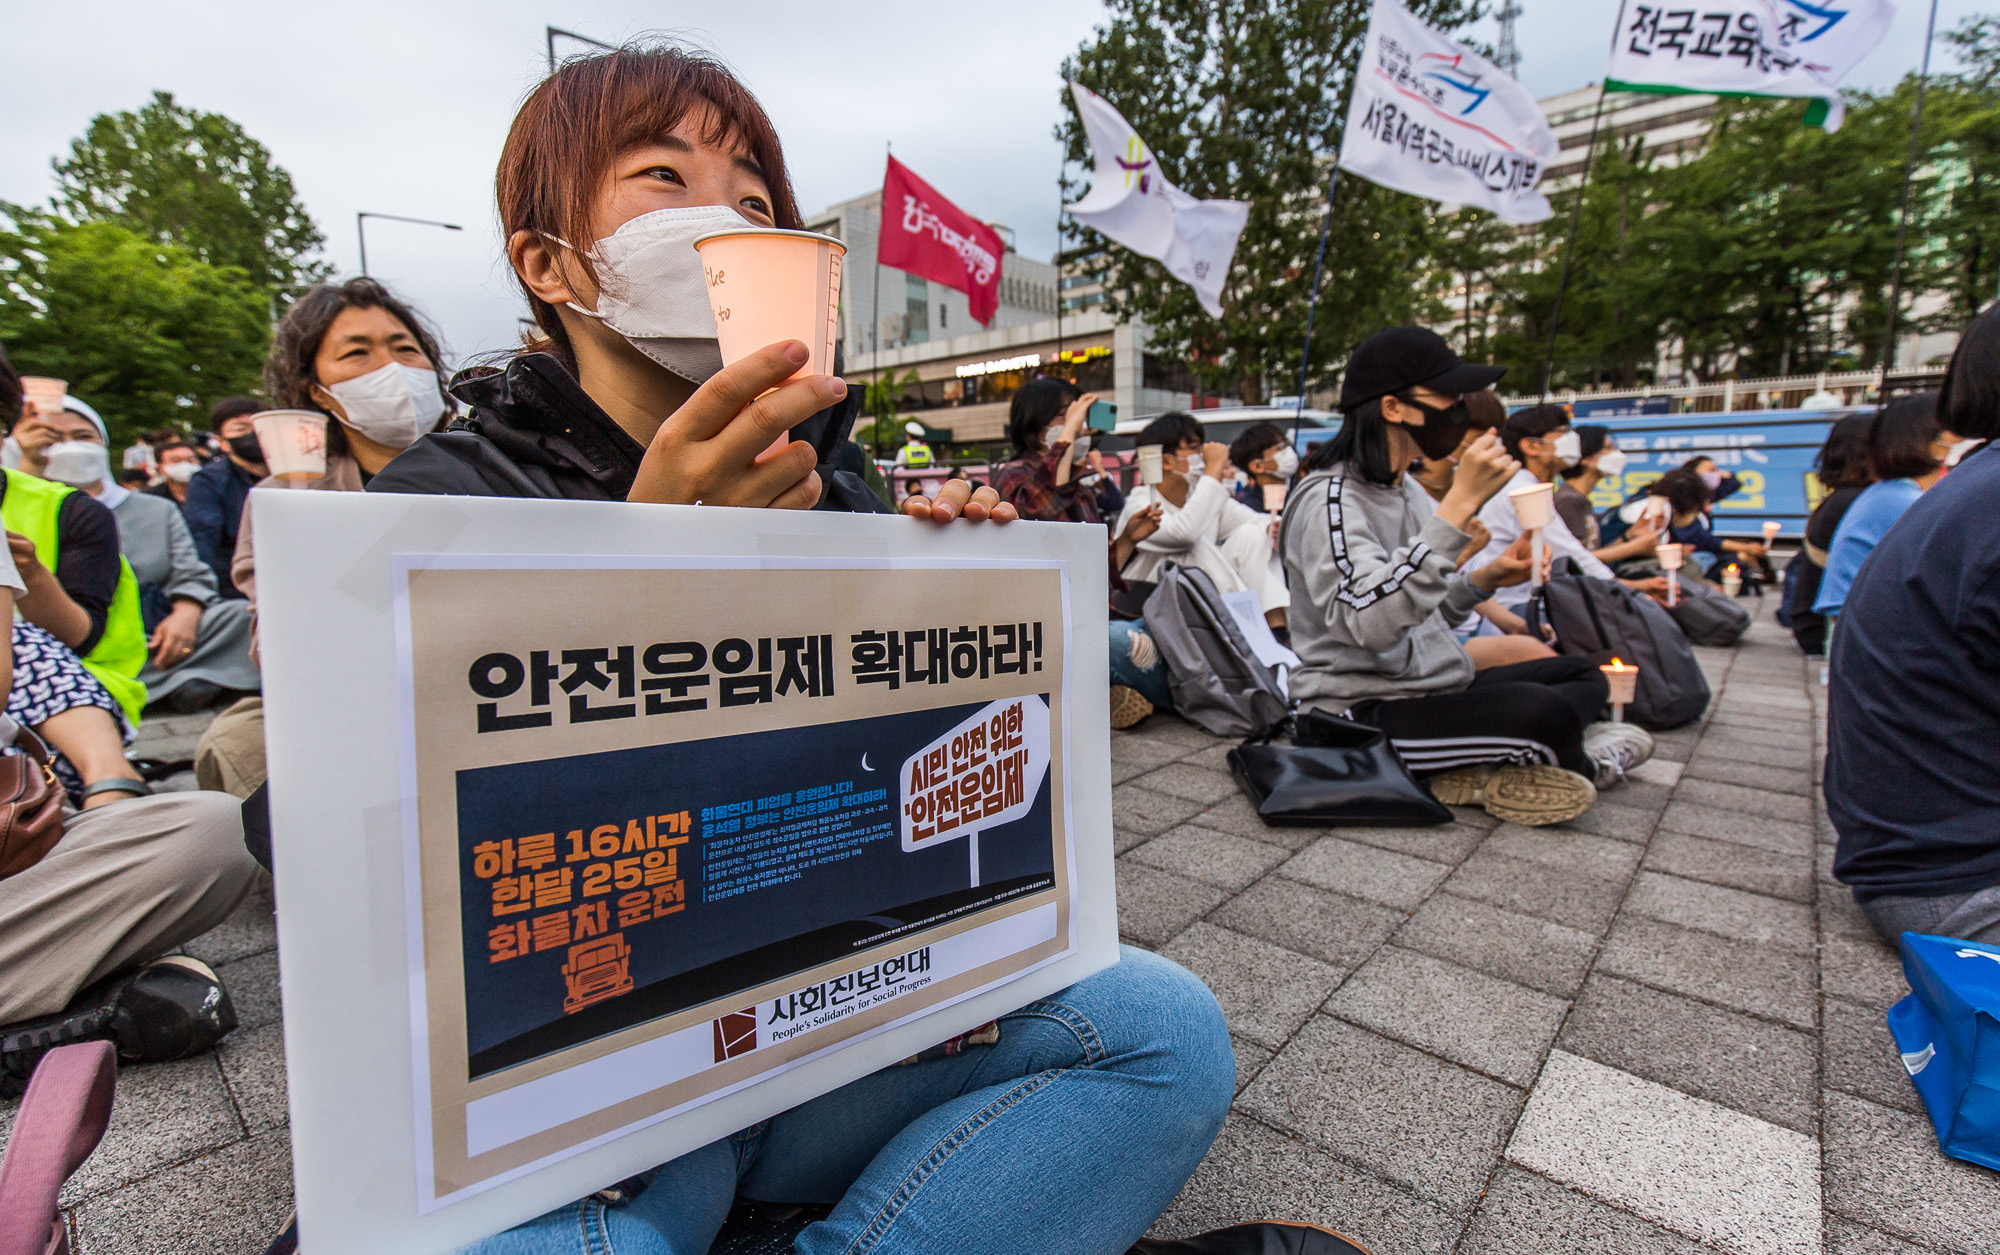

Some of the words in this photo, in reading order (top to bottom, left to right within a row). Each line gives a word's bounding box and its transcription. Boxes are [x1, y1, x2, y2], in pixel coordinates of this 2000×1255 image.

[468, 633, 835, 734] 안전운임제
[850, 621, 1043, 690] 확대하라!
[910, 743, 948, 796] 시민
[951, 721, 987, 777] 안전
[990, 701, 1023, 757] 위한
[701, 800, 753, 822] 화물연대
[757, 792, 792, 811] 파업을
[795, 781, 853, 804] 응원합니다!
[702, 818, 741, 838] 윤석열
[744, 812, 780, 829] 정부는
[783, 798, 839, 820] 안전운임제
[842, 788, 887, 807] 확대하라!
[904, 749, 1029, 843] '안전운임제'
[473, 832, 557, 879] 하루
[565, 811, 692, 863] 16시간
[492, 866, 574, 917] 한달
[582, 848, 677, 898] 25일
[488, 900, 610, 964] 화물차
[617, 879, 685, 928] 운전
[767, 946, 931, 1026] 사회진보연대
[772, 1021, 811, 1042] People's
[813, 1003, 856, 1027] Solidarity
[858, 997, 871, 1011] for
[872, 987, 897, 1004] Social
[899, 976, 932, 996] Progress
